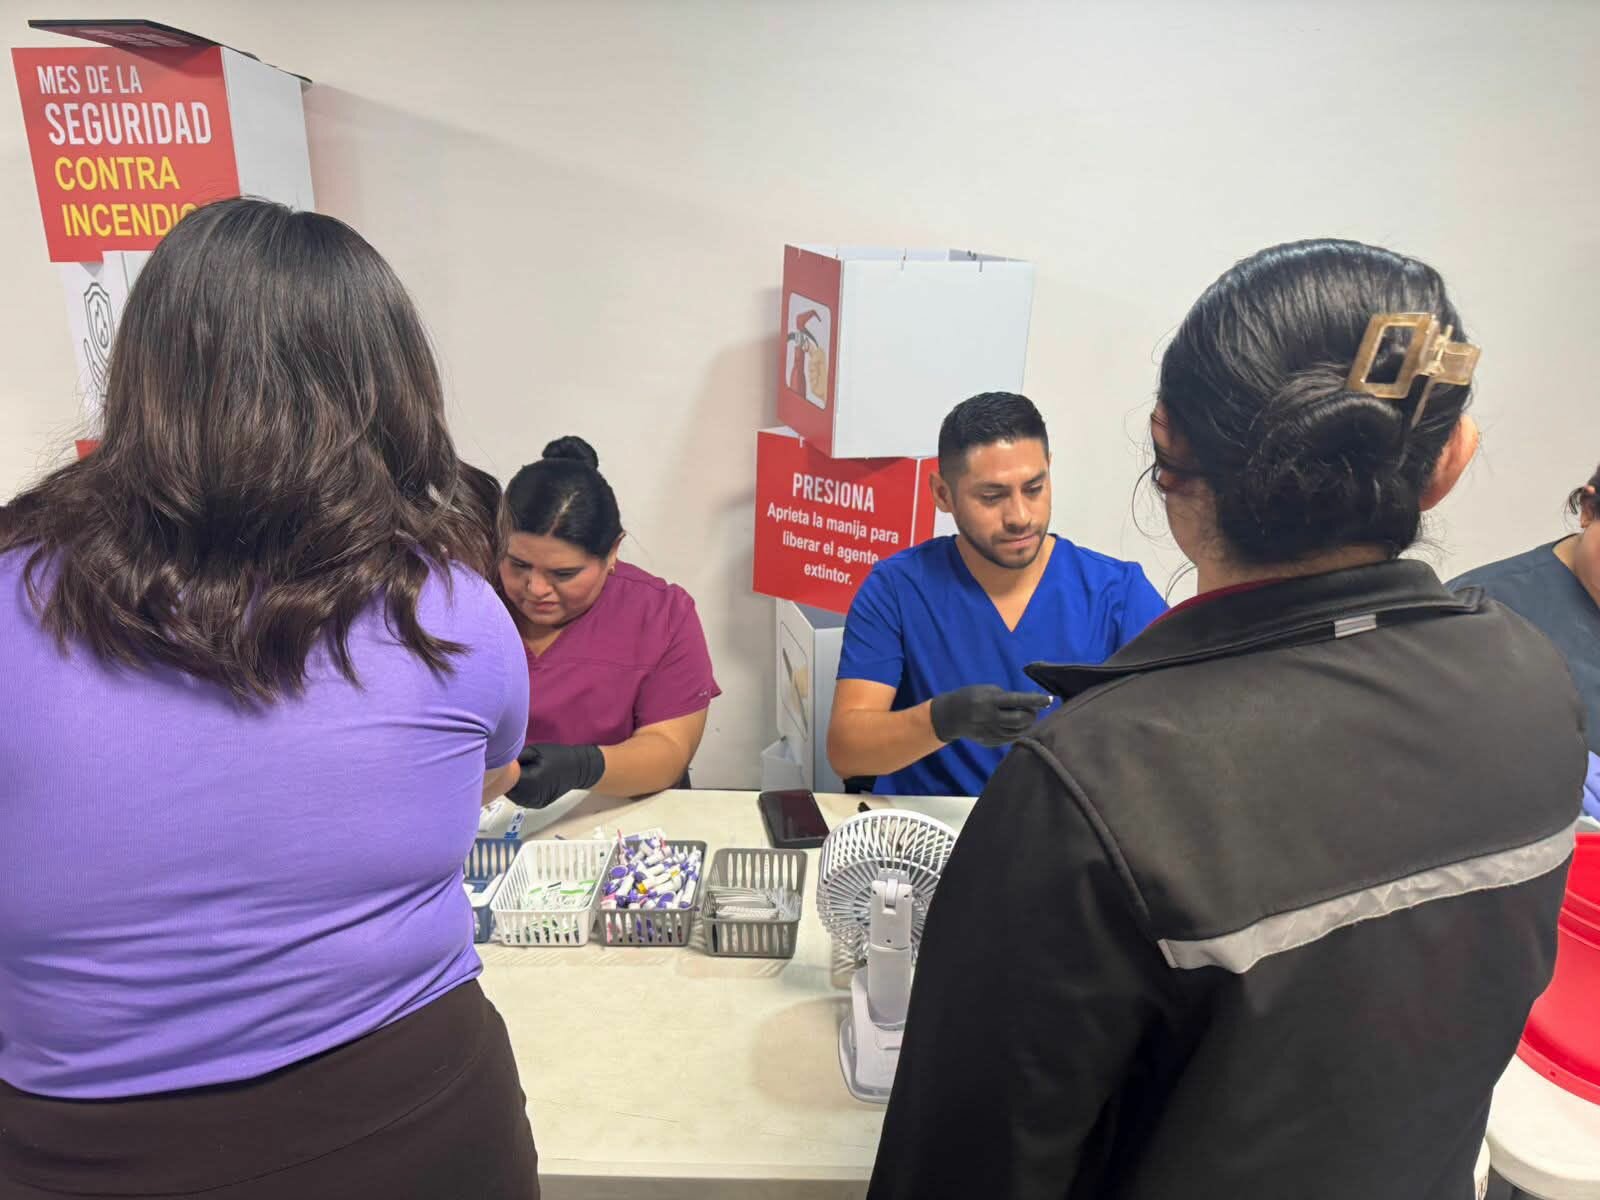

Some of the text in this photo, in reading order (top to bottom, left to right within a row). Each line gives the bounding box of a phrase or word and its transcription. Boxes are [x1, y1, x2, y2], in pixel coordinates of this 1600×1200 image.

[37, 65, 143, 94] MES DE LA
[44, 101, 212, 145] SEGURIDAD
[54, 156, 180, 191] CONTRA
[792, 472, 874, 513] PRESIONA
[767, 502, 899, 544] Aprieta la manija para
[782, 531, 879, 564] liberar el agente
[804, 564, 852, 585] extintor.
